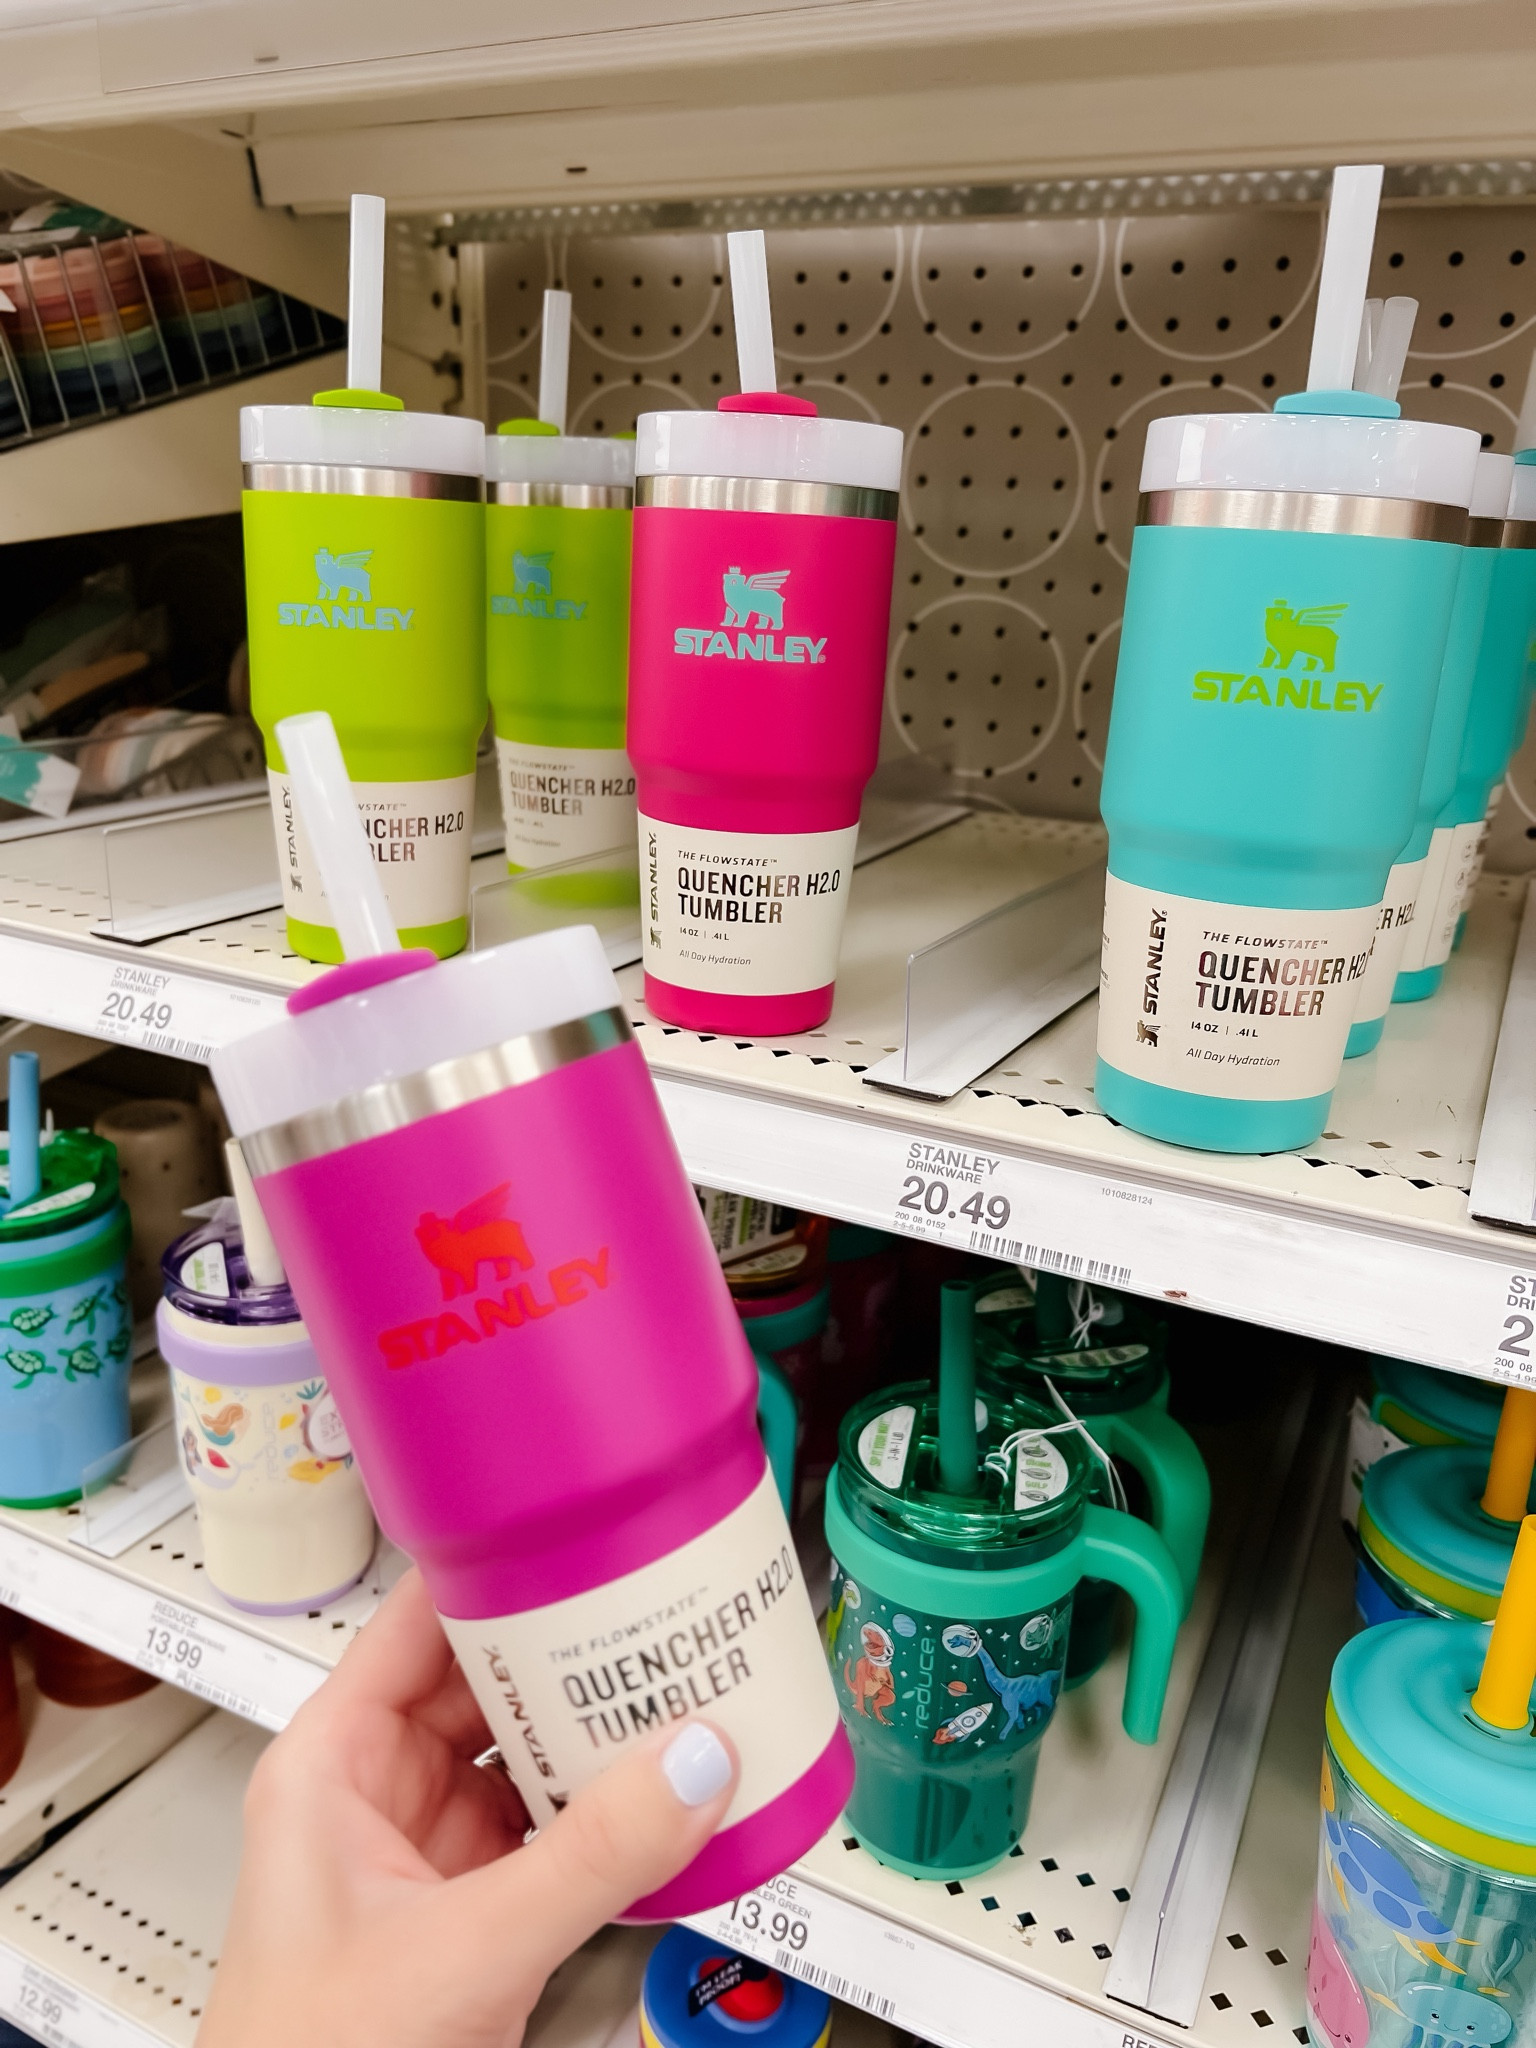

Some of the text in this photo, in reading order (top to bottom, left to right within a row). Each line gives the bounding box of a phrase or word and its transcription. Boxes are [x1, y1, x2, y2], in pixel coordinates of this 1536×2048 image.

[278, 602, 415, 631] STANLEY
[1192, 670, 1385, 713] STANLEY
[510, 771, 636, 797] QUENCHER H2.0
[512, 791, 583, 815] TUMBLER
[435, 811, 464, 836] H2.0
[677, 850, 696, 861] THE
[678, 867, 841, 897] QUENCHER H2.0
[677, 893, 783, 923] TUMBLER
[689, 928, 699, 937] OZ
[1203, 930, 1230, 944] THE
[679, 950, 751, 966] All Day Hydration
[1198, 950, 1345, 986] QUENCHER
[110, 979, 158, 997] DRINKWARE
[114, 966, 171, 989] STANLEY
[101, 992, 172, 1030] 20.49
[1195, 981, 1325, 1016] TUMBLER
[1191, 1021, 1202, 1031] 14
[1203, 1022, 1219, 1034] OZ
[1186, 1047, 1280, 1068] All Day Hydration
[906, 1159, 983, 1185] DRINKWARE
[909, 1142, 1000, 1176] STANLEY
[898, 1175, 1011, 1230] 20.49
[1102, 1187, 1153, 1206] 1010828124
[895, 1211, 946, 1230] 200 08 0152
[377, 1245, 610, 1371] STANLEY
[1494, 1356, 1533, 1373] 200 08
[154, 1601, 199, 1628] REDUCE
[562, 1544, 795, 1709] QUENCHER H2.0
[147, 1627, 203, 1669] 13.99
[548, 1643, 582, 1664] THE
[914, 1637, 935, 1729] reduce
[576, 1646, 753, 1749] TUMBLER
[778, 1897, 812, 1919] GREEN
[730, 1896, 808, 1951] 13.99
[20, 1985, 63, 2024] 12.99
